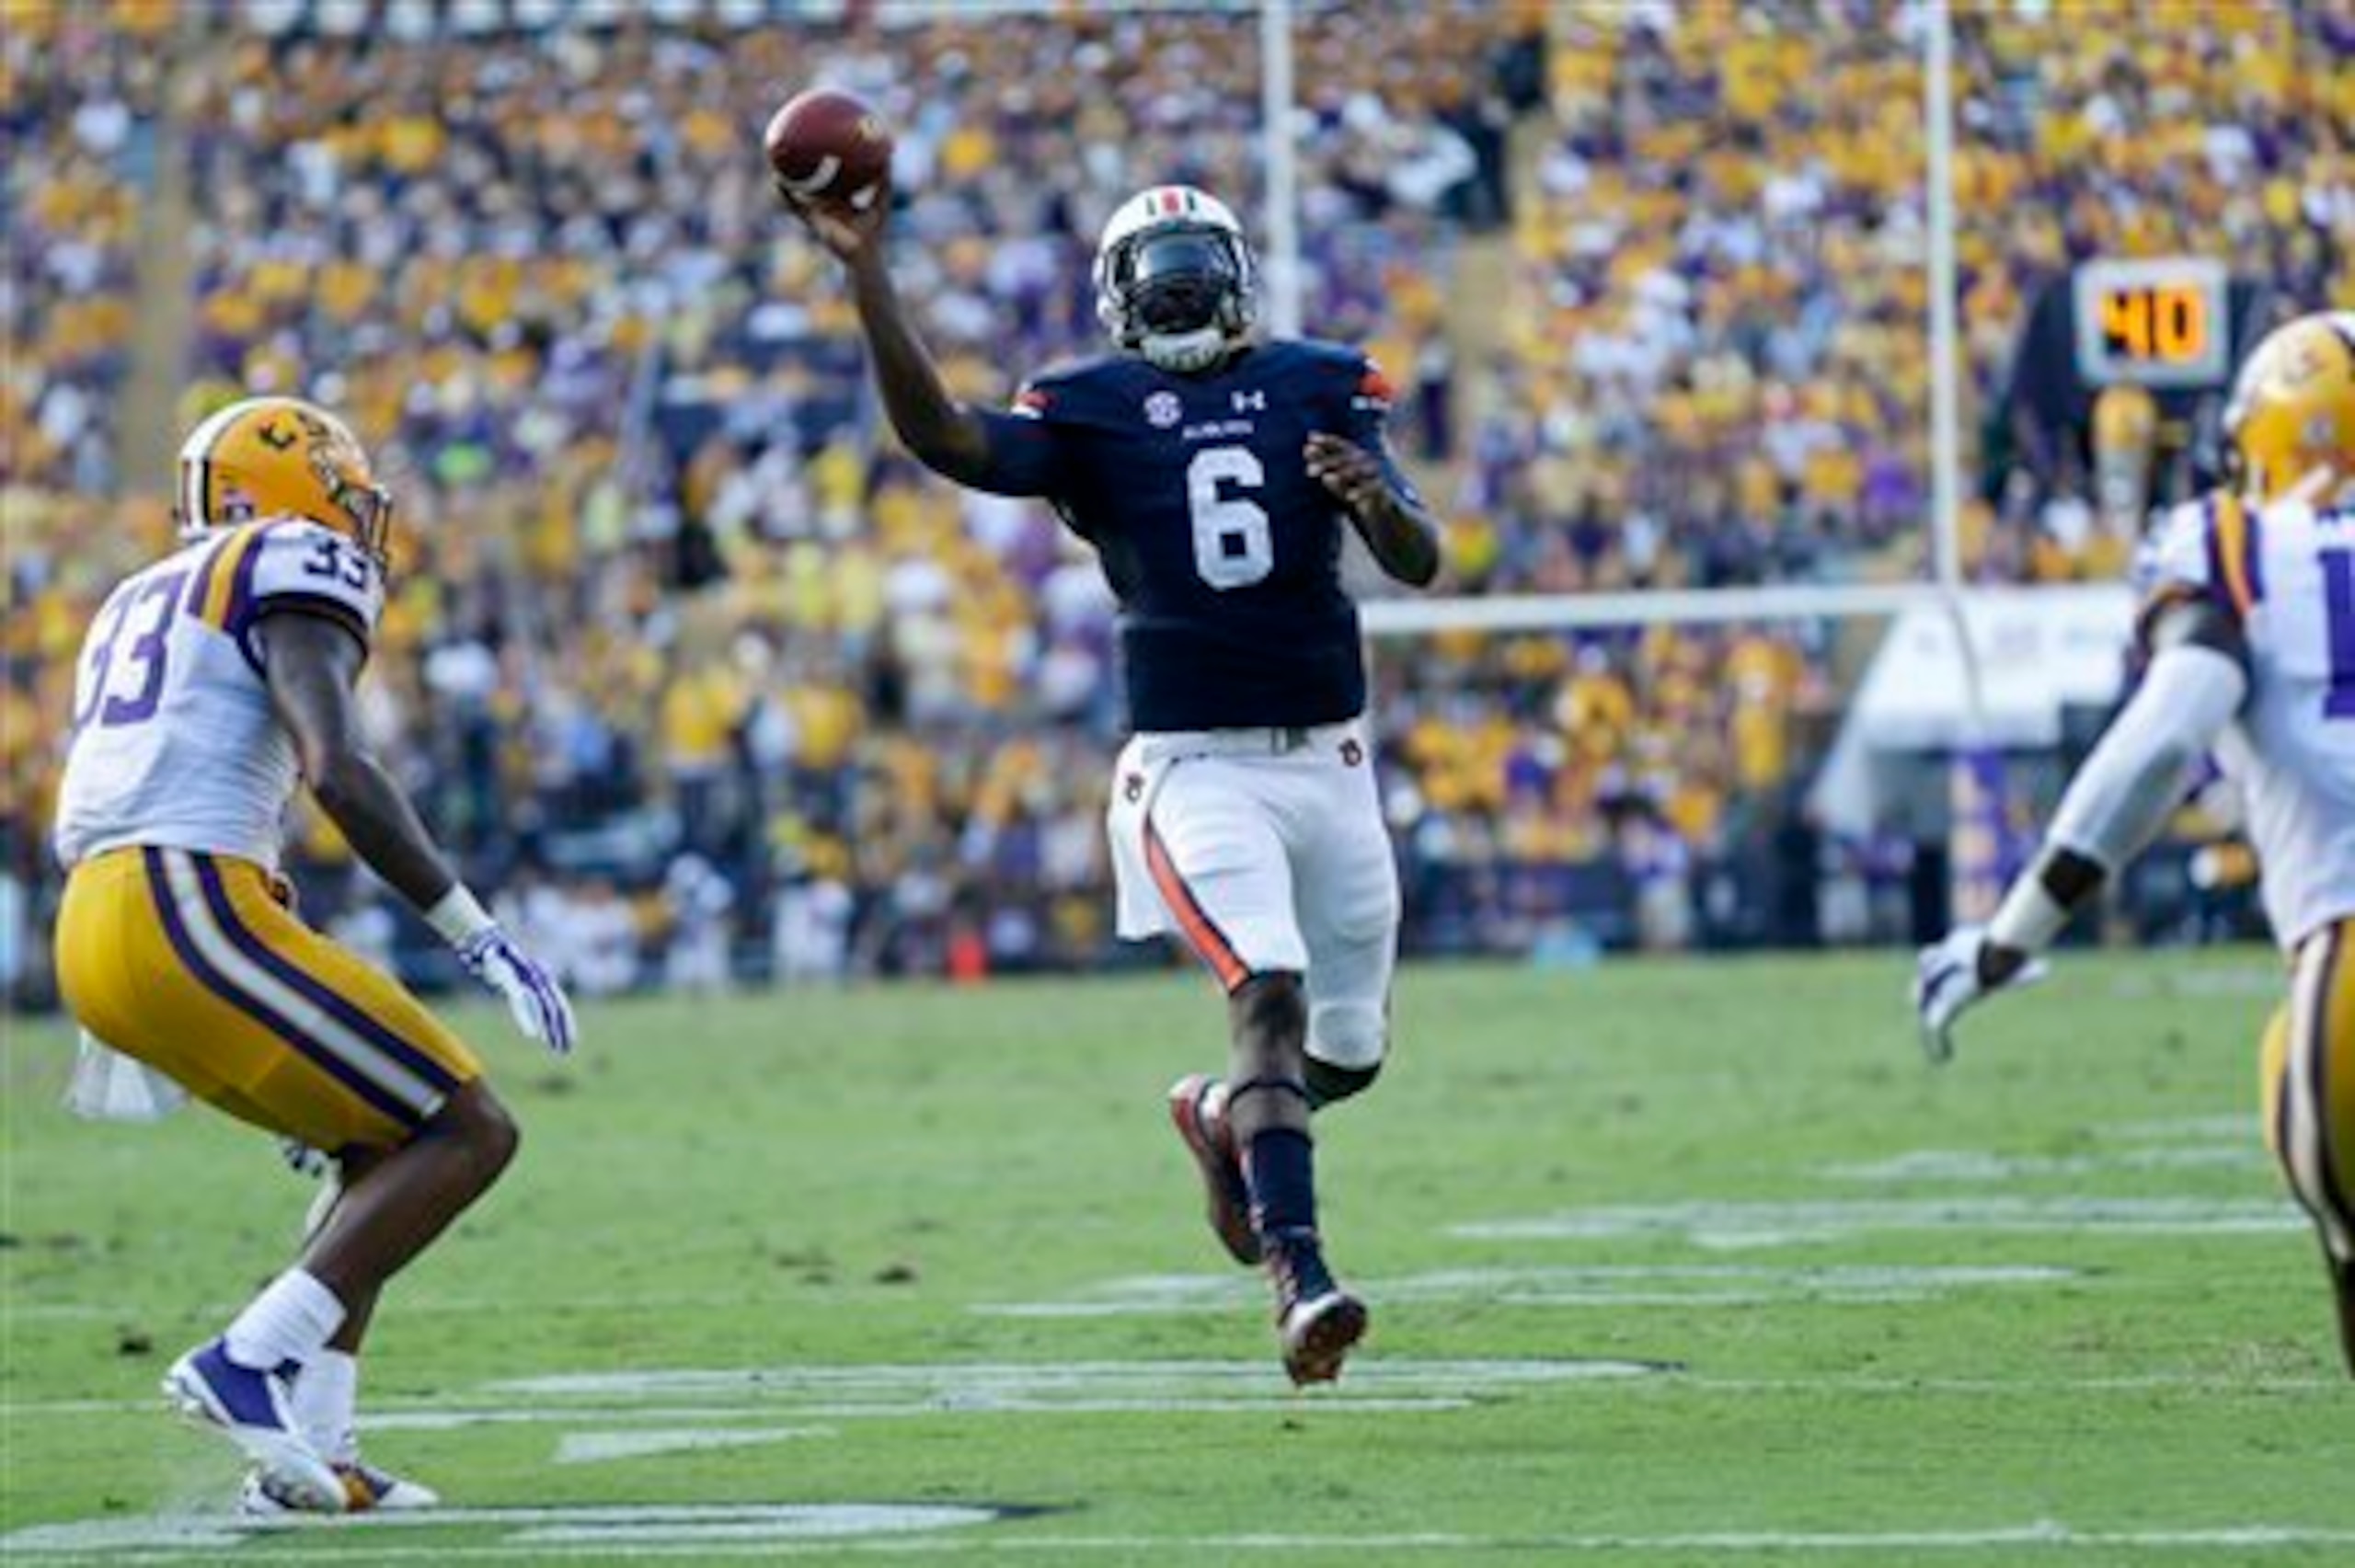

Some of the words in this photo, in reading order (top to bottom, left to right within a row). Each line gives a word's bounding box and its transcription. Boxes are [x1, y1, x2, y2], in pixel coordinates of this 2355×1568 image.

[2097, 287, 2207, 361] 40
[303, 538, 367, 592] 33
[1188, 446, 1274, 590] 6
[74, 568, 190, 733] 33
